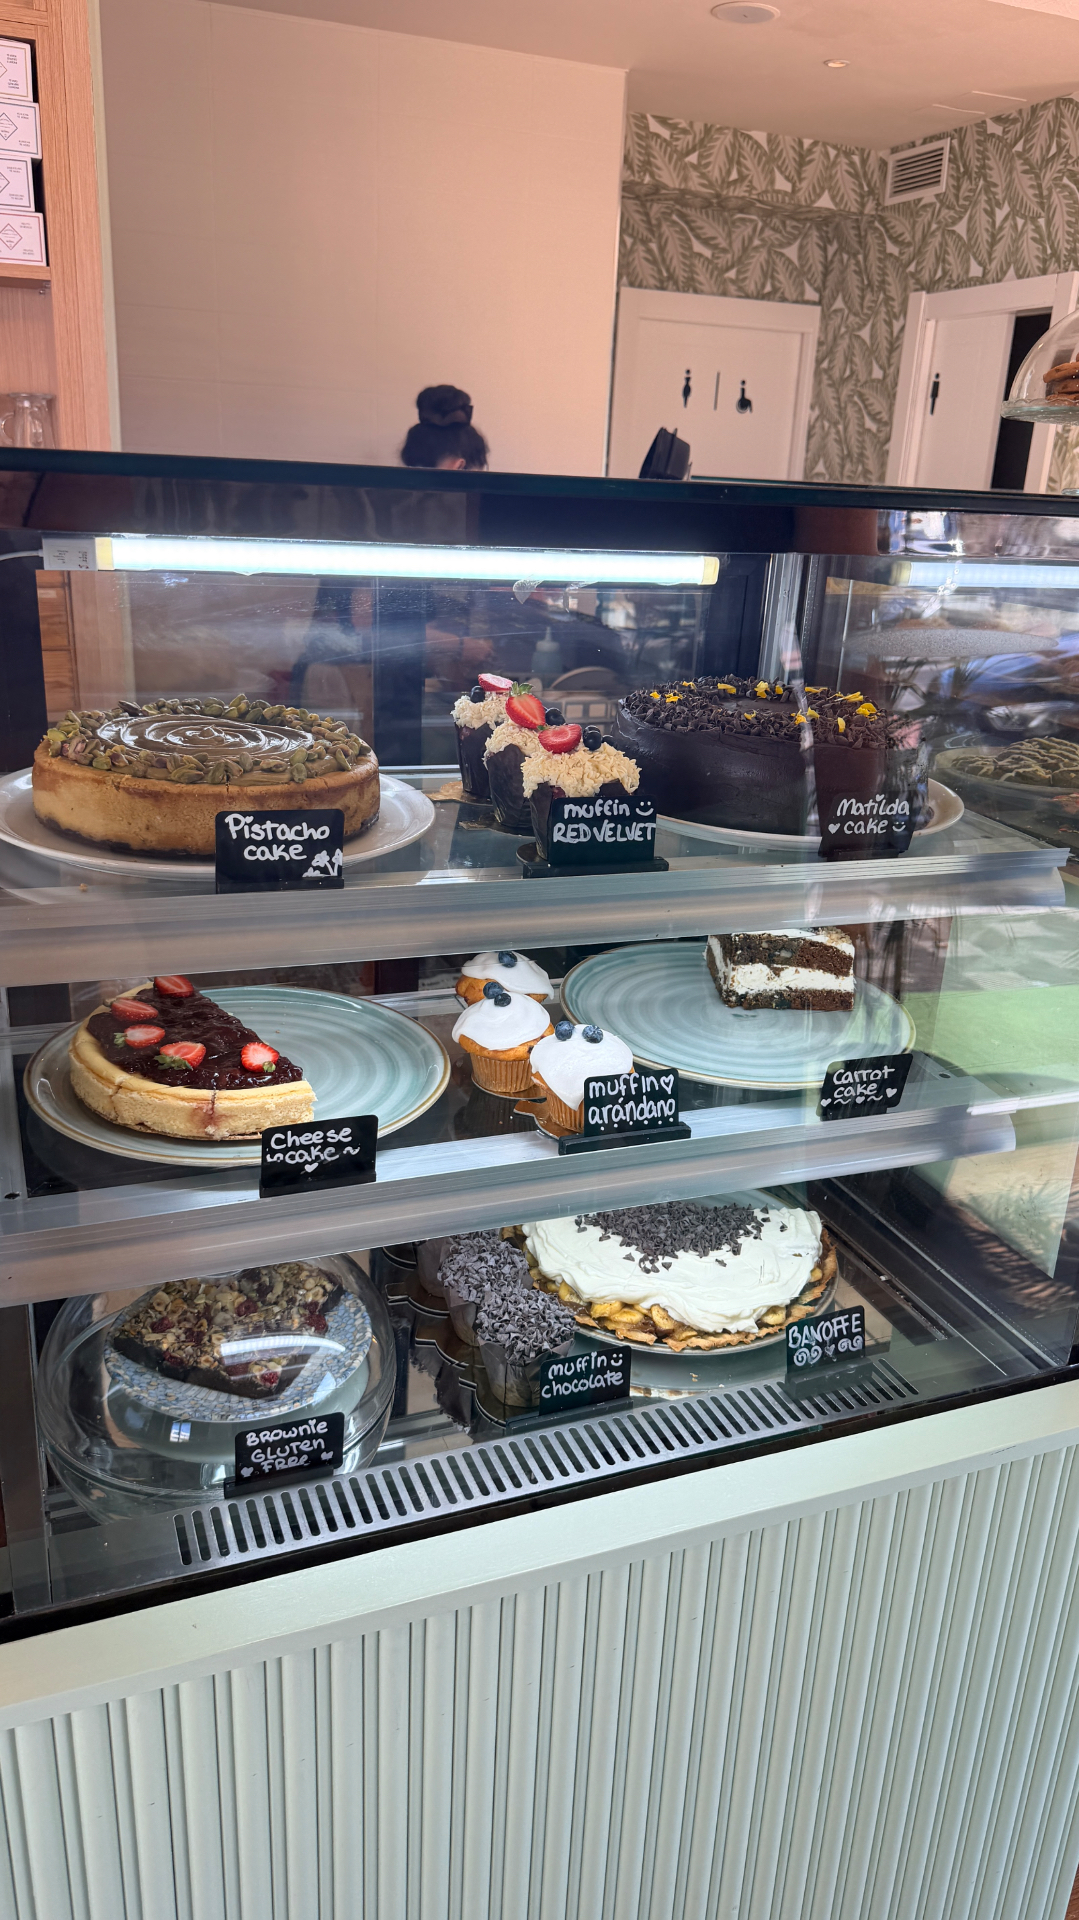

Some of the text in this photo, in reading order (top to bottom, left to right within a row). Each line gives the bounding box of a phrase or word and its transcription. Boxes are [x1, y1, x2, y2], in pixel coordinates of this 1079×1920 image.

[563, 799, 630, 820] muffin
[224, 813, 330, 841] Pistacho
[843, 818, 889, 835] cake
[243, 844, 307, 861] cake
[588, 1072, 659, 1099] muffin
[833, 1082, 878, 1099] cake
[588, 1095, 676, 1125] arándano
[270, 1127, 352, 1150] Cheese
[284, 1145, 340, 1165] cake
[788, 1313, 862, 1349] BANOFFE
[548, 1351, 608, 1380] muffin
[541, 1370, 624, 1399] chocolate
